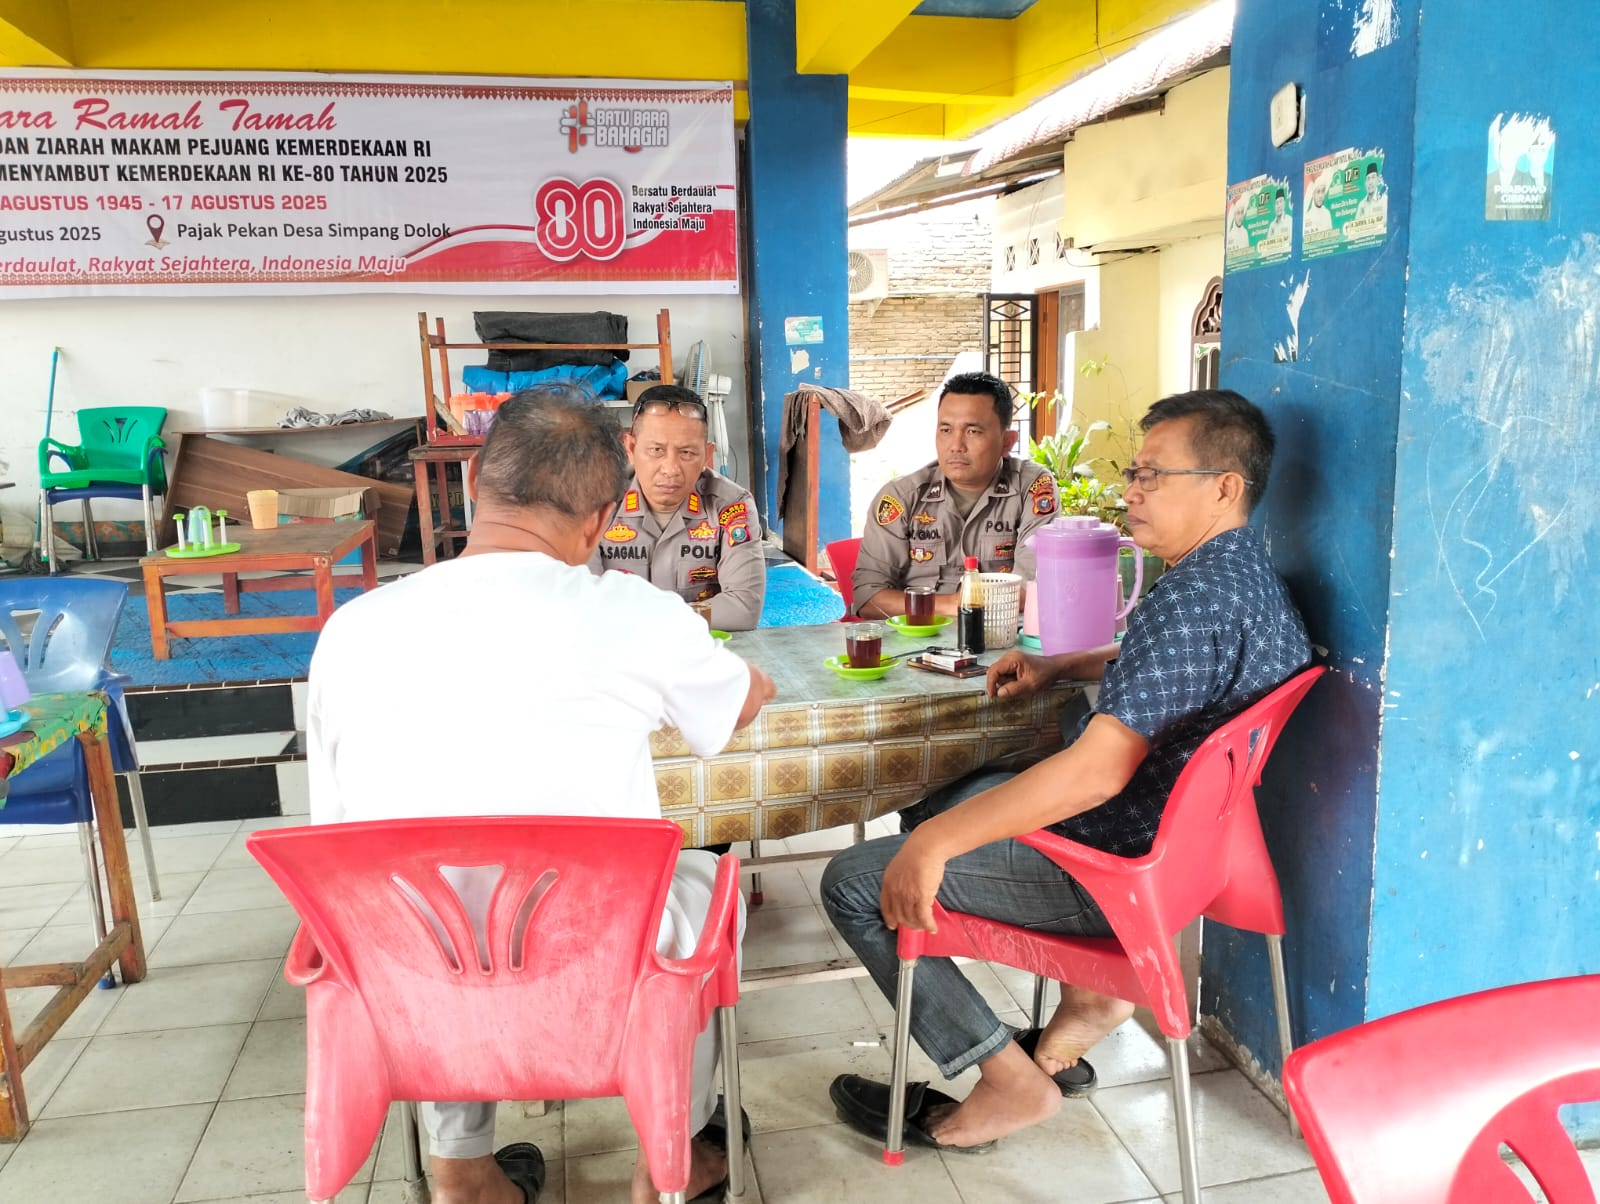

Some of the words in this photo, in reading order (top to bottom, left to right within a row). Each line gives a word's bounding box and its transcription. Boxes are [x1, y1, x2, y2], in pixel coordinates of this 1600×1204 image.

[0, 111, 56, 130] ara
[73, 97, 204, 131] Ramah
[219, 98, 336, 132] Tamah
[596, 109, 630, 127] BATU
[633, 110, 669, 128] BARA
[595, 126, 669, 147] BAHAGIA
[36, 137, 105, 156] ZIARAH
[111, 138, 181, 156] MAKAM
[188, 138, 270, 157] PEJUANG
[276, 138, 408, 157] KEMERDEKAAN
[414, 140, 432, 158] RI
[116, 164, 252, 182] KEMERDEKAAN
[257, 164, 276, 182] RI
[281, 164, 335, 182] KE-80
[339, 164, 399, 183] TAHUN
[405, 165, 448, 184] 2025
[631, 184, 668, 198] Bersatu
[670, 185, 717, 199] Berdaulat
[0, 195, 89, 211] AGUSTUS
[96, 195, 143, 211] 1945
[162, 194, 184, 210] 17
[191, 194, 275, 211] AGUSTUS
[281, 194, 328, 211] 2025
[632, 201, 665, 217] Rakyat
[666, 201, 713, 217] Sejahtera
[535, 176, 627, 263] 80
[633, 217, 679, 231] Indonesia
[681, 217, 705, 233] Maju
[0, 228, 54, 245] gustus
[59, 226, 102, 241] 2025
[177, 222, 223, 241] Pajak
[227, 222, 278, 238] Pekan
[283, 223, 323, 238] Desa
[328, 222, 400, 243] Simpang
[405, 222, 452, 239] Dolok
[88, 256, 155, 276] Rakyat
[159, 255, 257, 276] Sejahtera,
[261, 254, 353, 272] Indonesia
[358, 254, 407, 276] Maju
